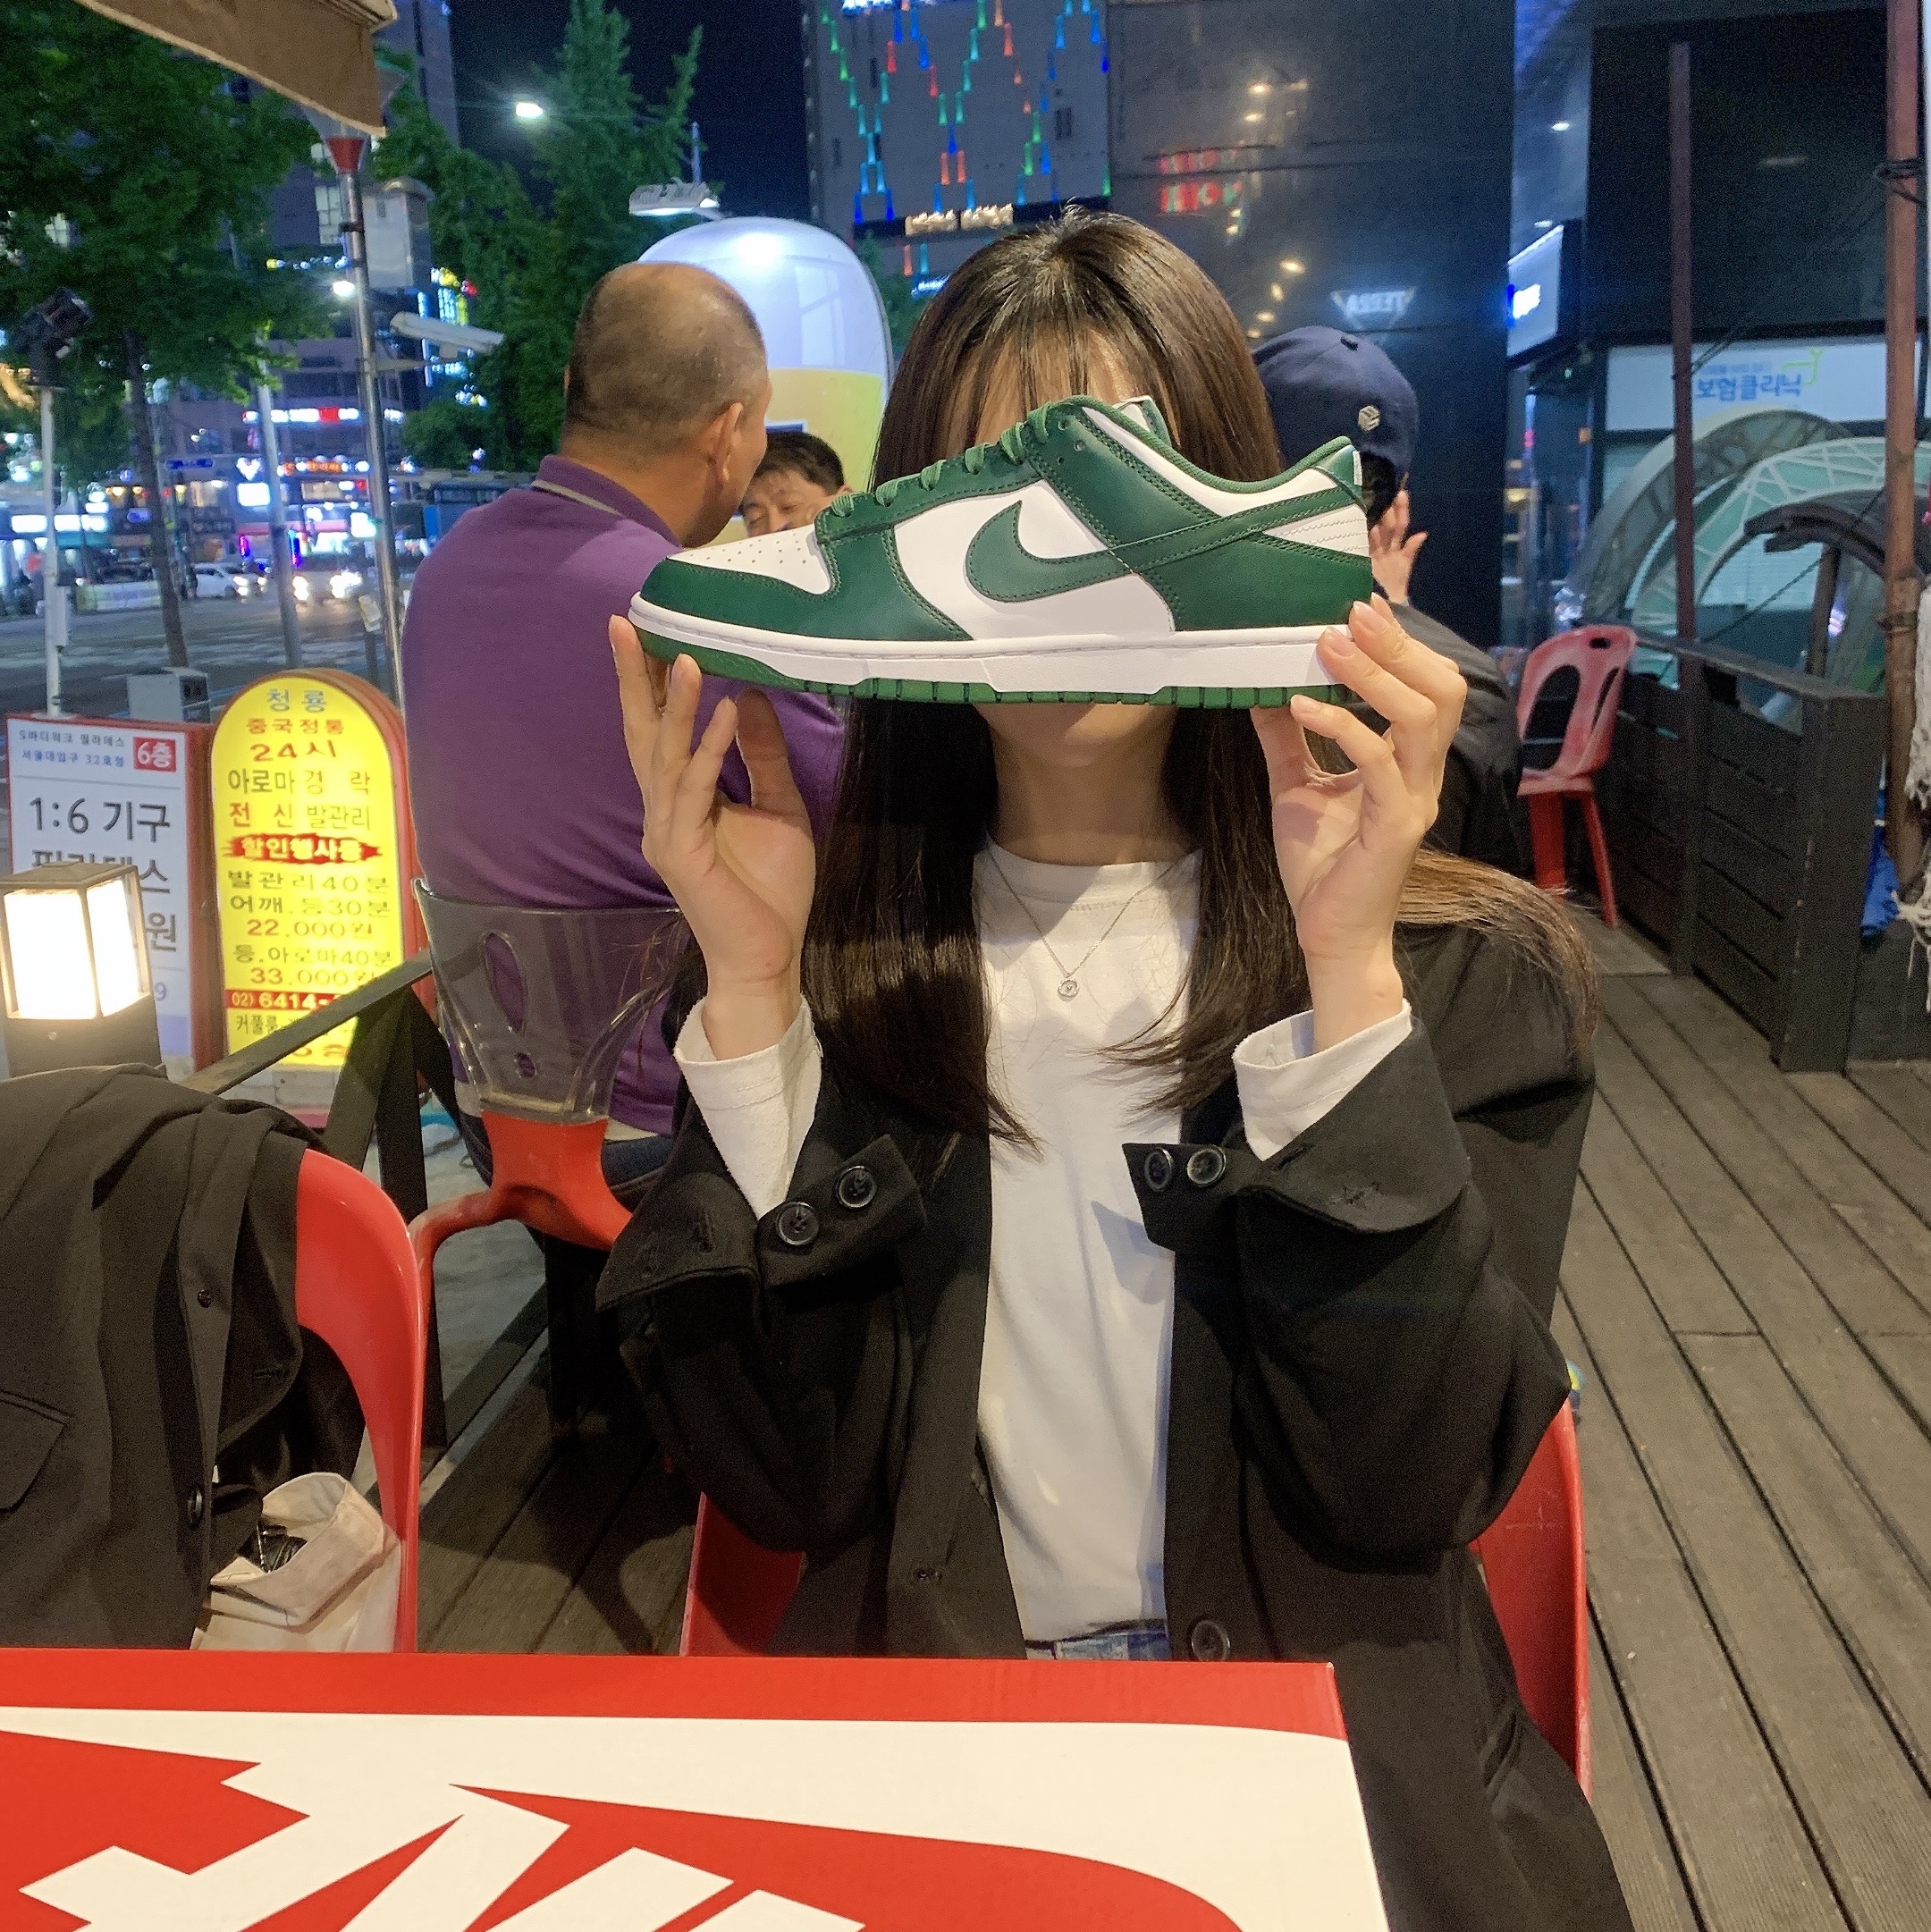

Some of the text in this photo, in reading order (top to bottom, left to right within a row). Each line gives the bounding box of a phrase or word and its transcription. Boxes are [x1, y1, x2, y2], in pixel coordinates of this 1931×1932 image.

[1695, 374, 1802, 401] 보험클리닉
[137, 741, 173, 768] 6층
[249, 739, 337, 762] 24시
[30, 797, 171, 843] 1:6 기구
